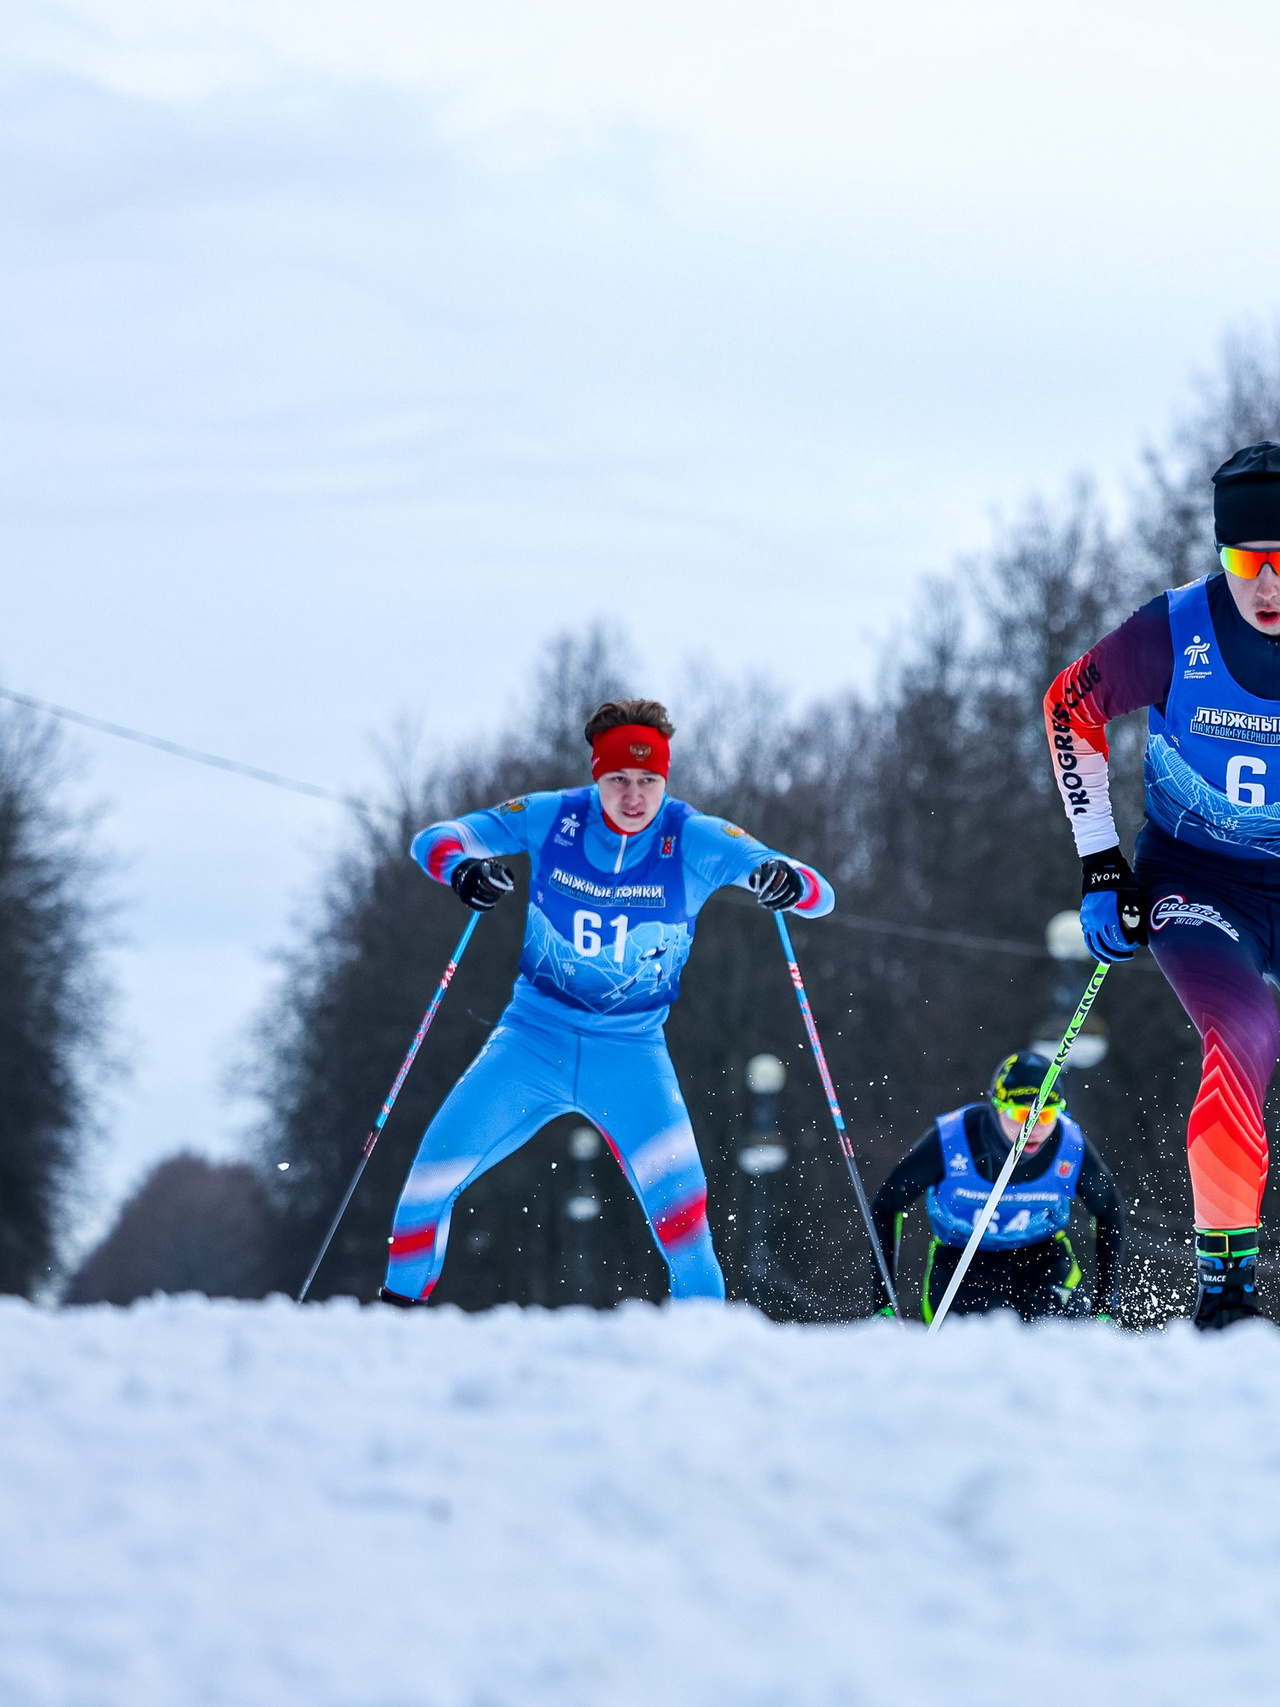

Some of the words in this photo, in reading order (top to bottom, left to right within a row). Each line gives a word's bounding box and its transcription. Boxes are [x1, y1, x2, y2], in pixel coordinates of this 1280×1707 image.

[1066, 662, 1102, 709] CLUB
[1192, 721, 1204, 732] НА
[1205, 725, 1231, 738] КУБОК
[1052, 703, 1090, 815] ROGRES
[553, 868, 612, 898] ЛЫЖНЫЕ
[615, 886, 662, 899] ГОНКИ
[1091, 873, 1121, 885] MOAX
[573, 909, 629, 963] 61
[1158, 902, 1240, 937] PROGRESS
[1174, 917, 1185, 925] SKI
[1185, 917, 1204, 927] CLUB
